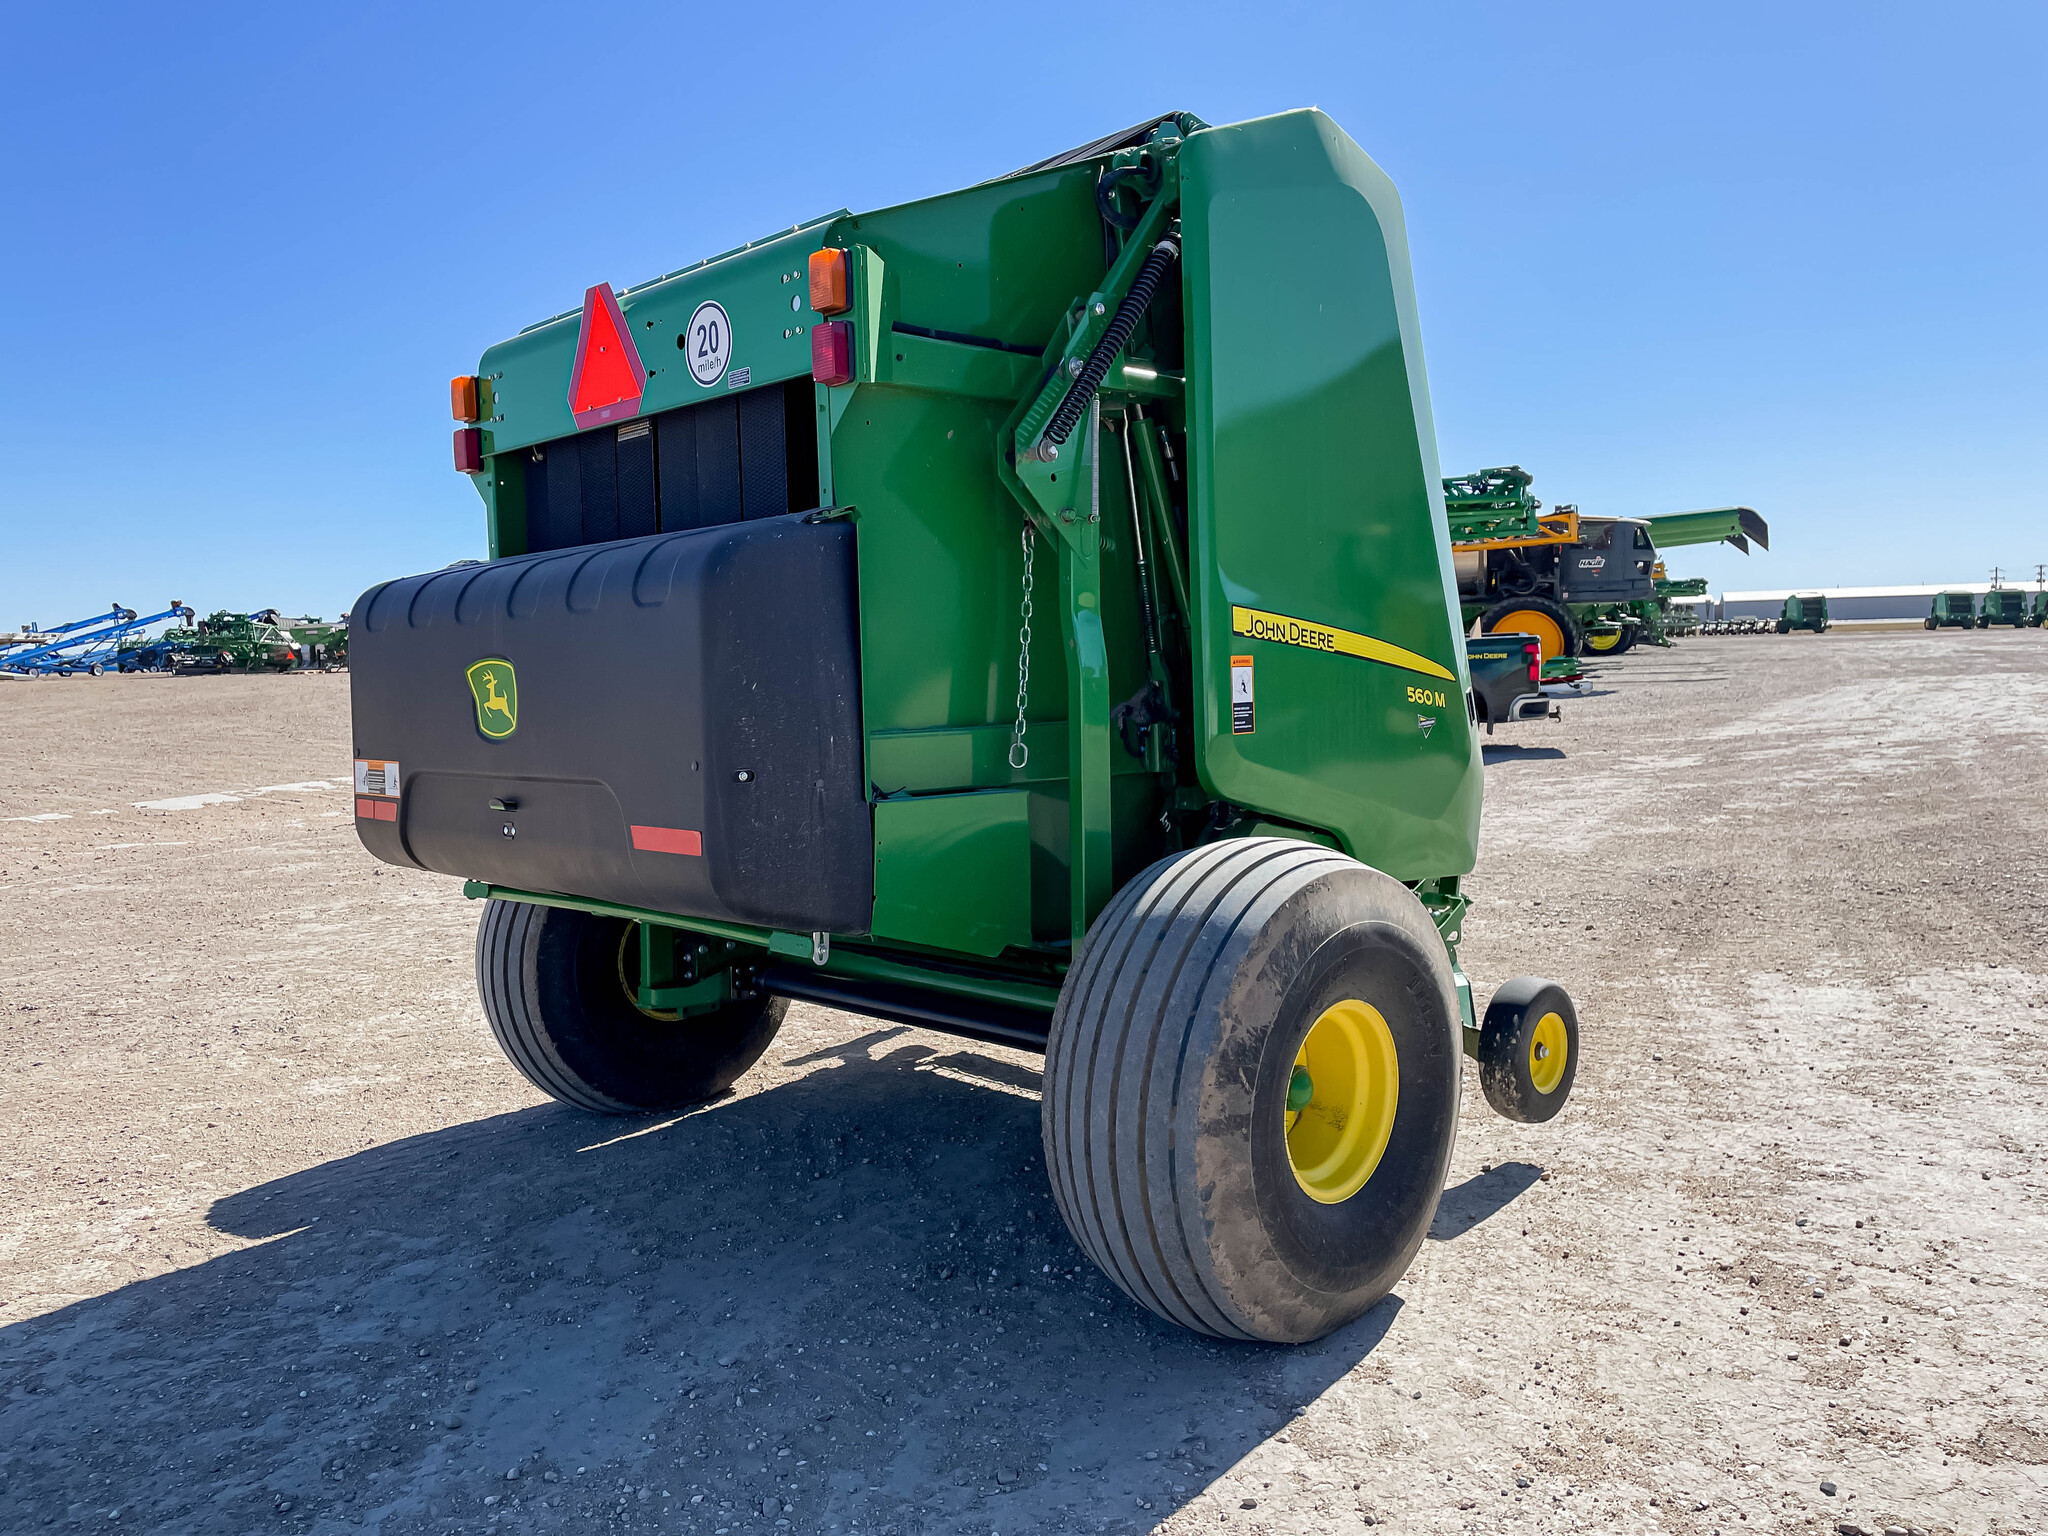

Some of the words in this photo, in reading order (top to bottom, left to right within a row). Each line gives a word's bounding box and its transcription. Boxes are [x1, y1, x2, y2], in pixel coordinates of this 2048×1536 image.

[697, 320, 719, 358] 20
[698, 356, 722, 373] mile/h
[1245, 614, 1286, 640] JOHN
[1289, 622, 1335, 649] DEERE
[1407, 686, 1433, 706] 560
[1434, 691, 1446, 708] M
